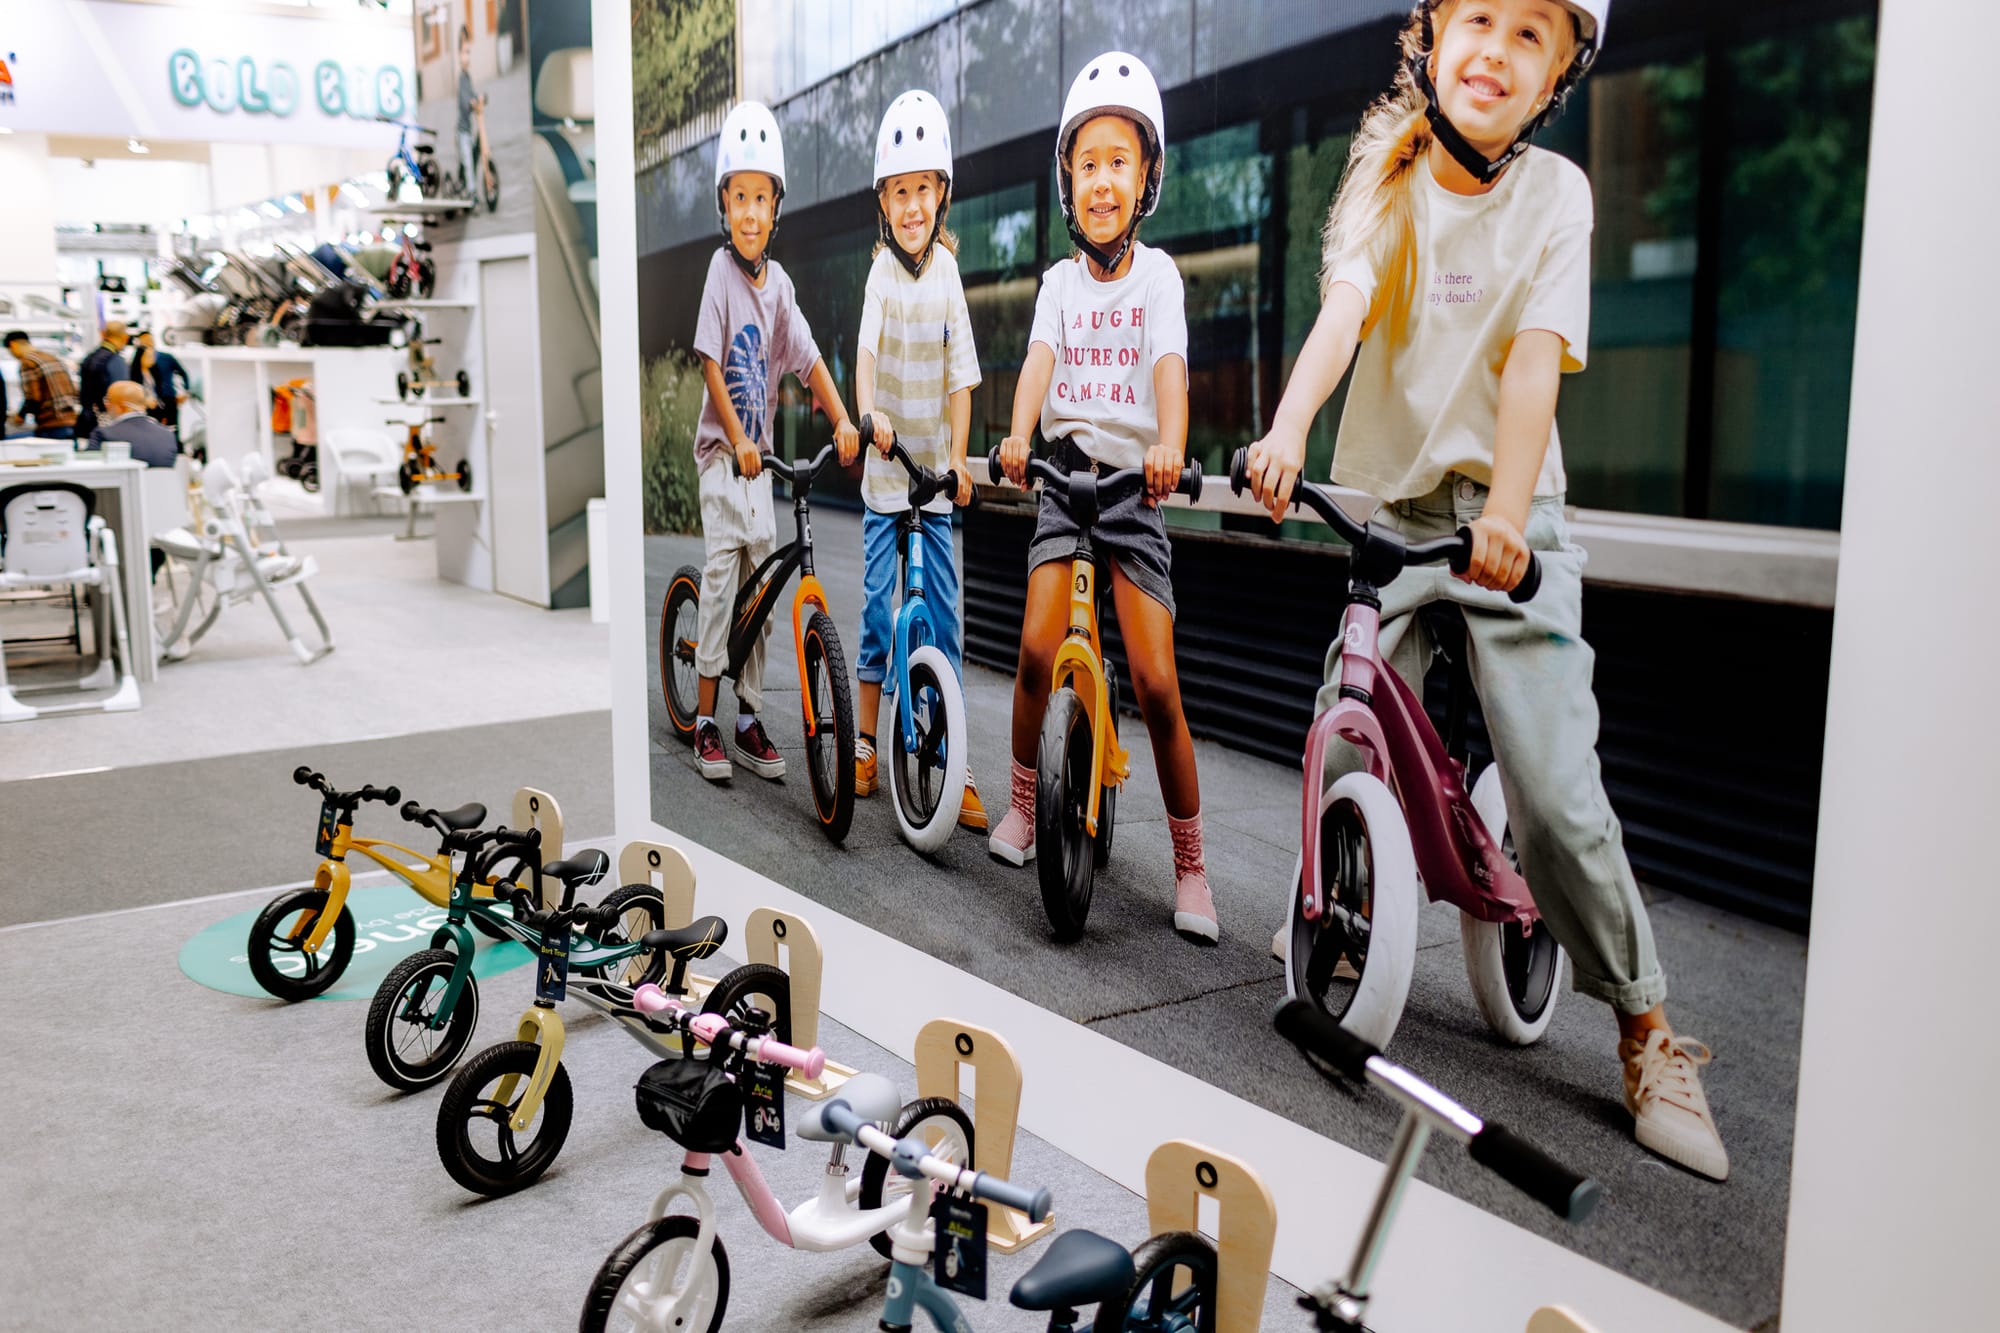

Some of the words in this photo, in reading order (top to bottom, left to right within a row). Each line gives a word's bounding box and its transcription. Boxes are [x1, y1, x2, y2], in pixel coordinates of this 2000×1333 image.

[315, 60, 414, 119] BAB
[1445, 272, 1472, 284] there
[1445, 289, 1483, 303] doubt?
[1057, 382, 1136, 405] CAMERA
